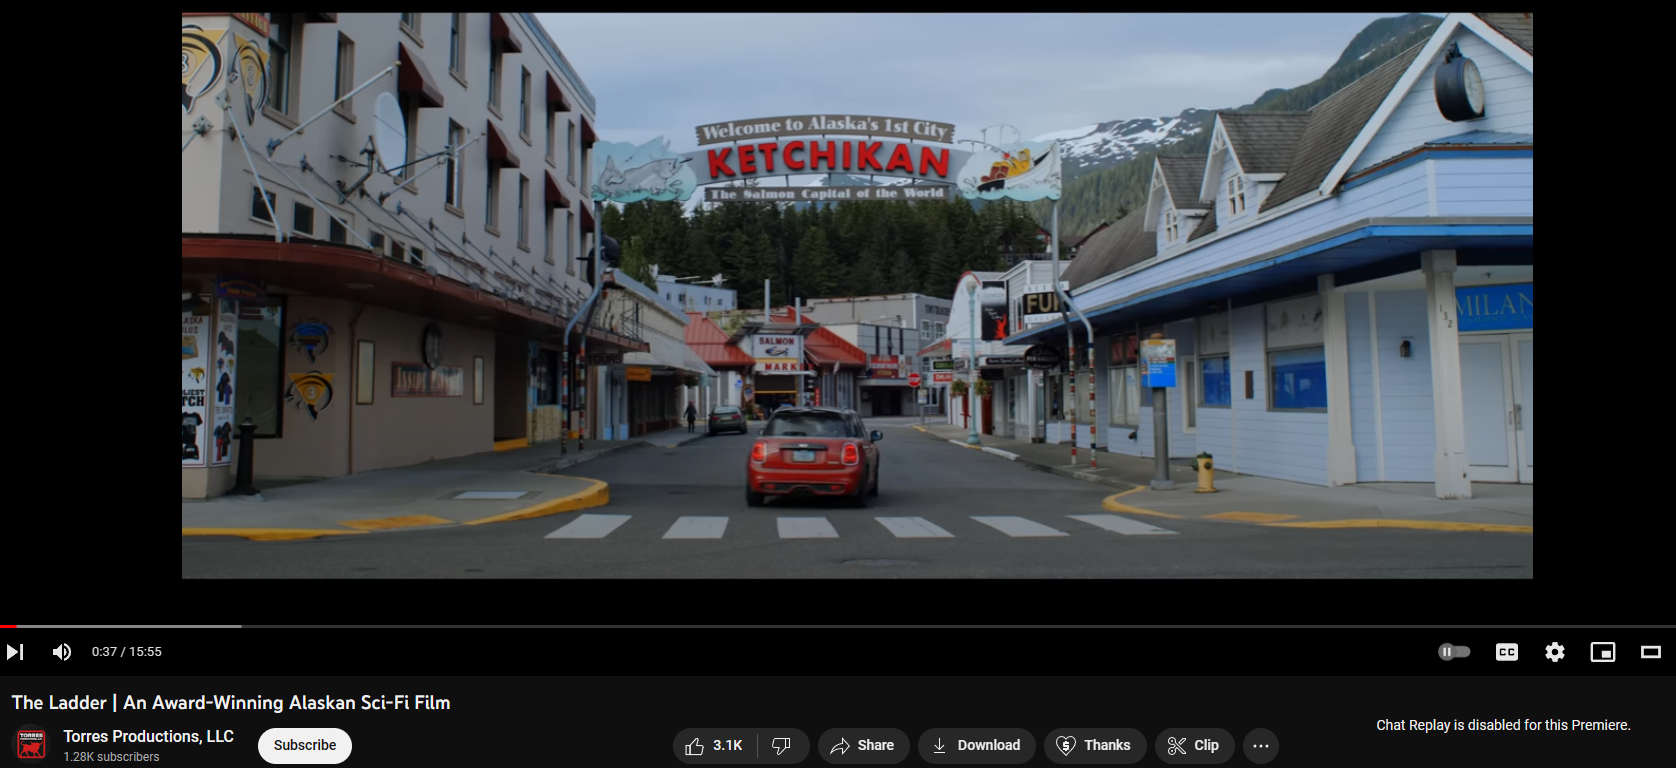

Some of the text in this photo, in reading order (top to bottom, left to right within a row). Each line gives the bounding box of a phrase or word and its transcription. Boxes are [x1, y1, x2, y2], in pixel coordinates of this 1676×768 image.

[703, 116, 948, 141] Welcome to Alaska's 1st City
[707, 140, 950, 178] KETCHIKAN
[710, 188, 944, 200] The Salmon Capital of the World
[1028, 284, 1065, 292] SITA
[1440, 304, 1453, 328] 132
[1460, 315, 1508, 324] IAMOND
[759, 337, 794, 345] SALMON
[588, 354, 622, 364] TOURS
[309, 386, 316, 398] 3
